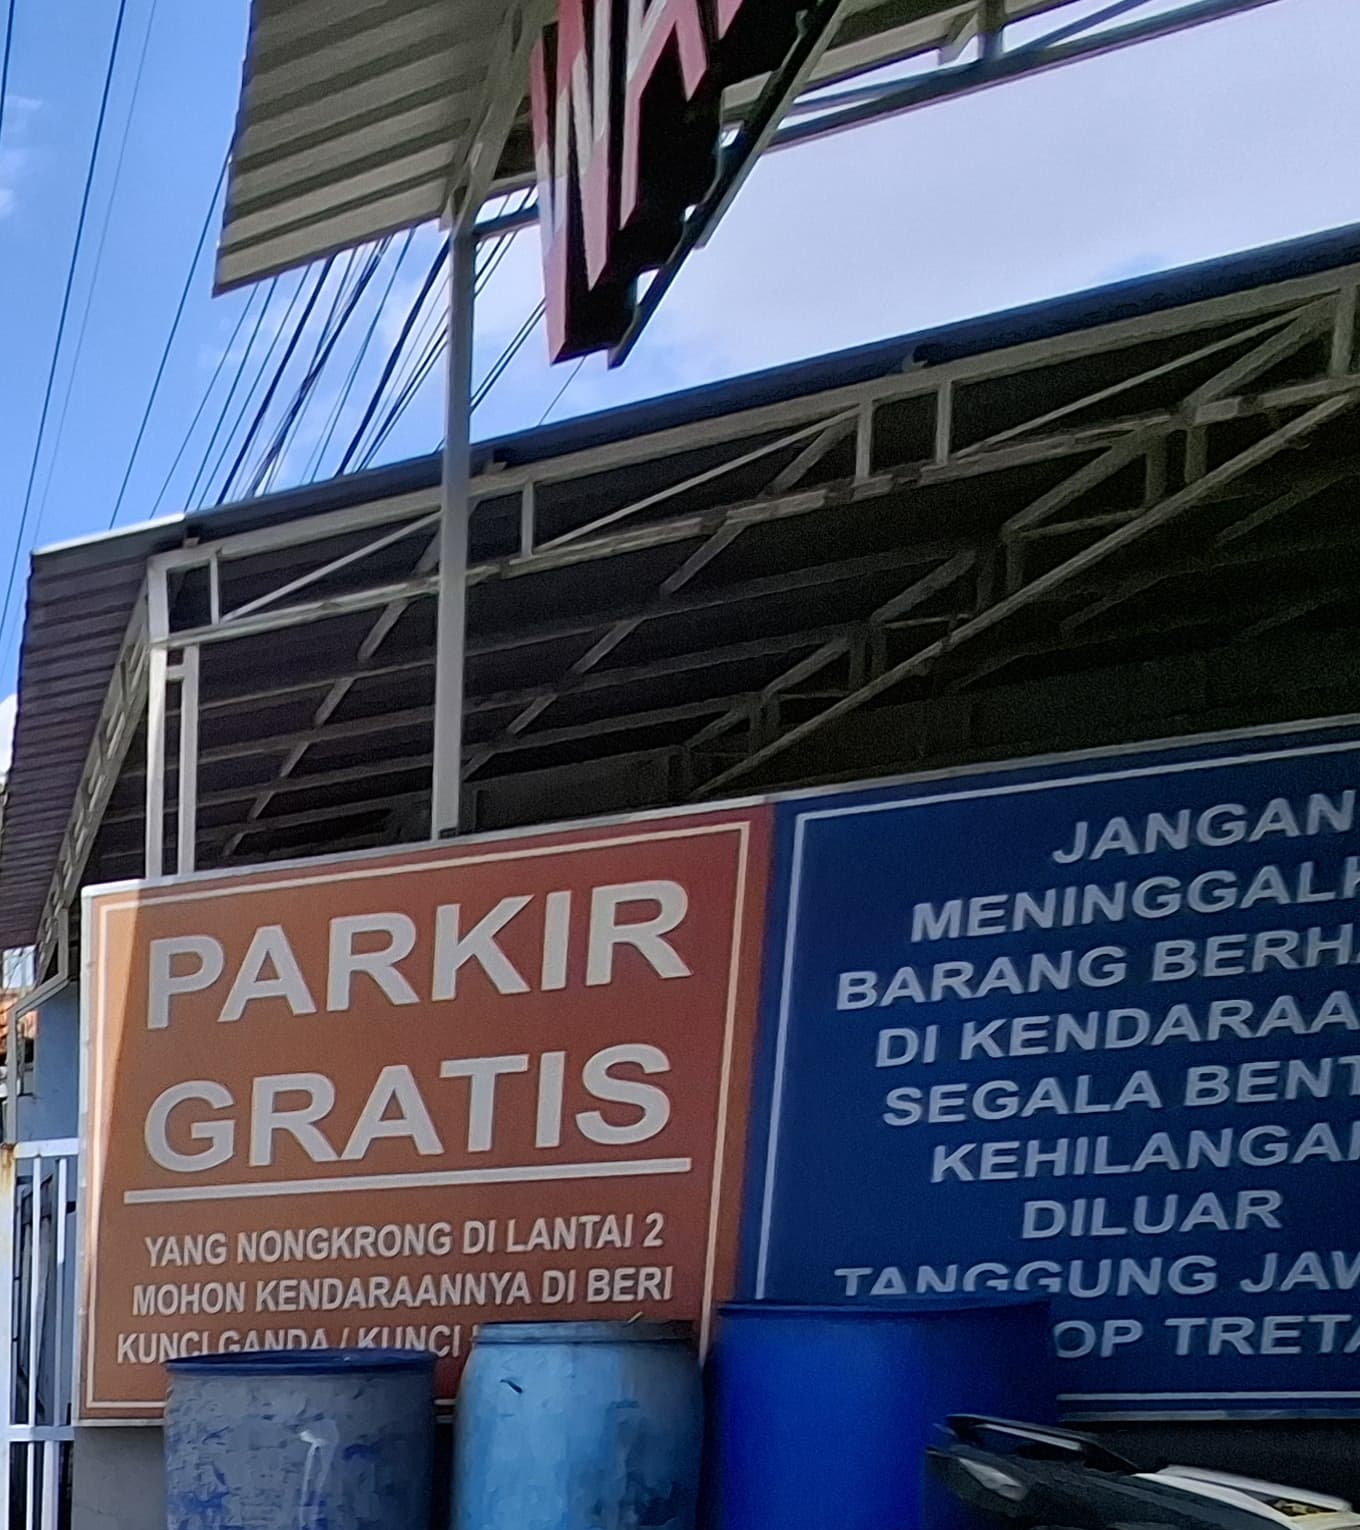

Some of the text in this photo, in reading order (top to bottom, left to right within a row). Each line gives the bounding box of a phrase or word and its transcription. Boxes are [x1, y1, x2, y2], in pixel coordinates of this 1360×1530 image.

[1051, 790, 1357, 864] JANGAN
[146, 880, 692, 1030] PARKIR
[836, 922, 1360, 1010] BARANG BERH
[875, 1024, 938, 1067] DI
[144, 1043, 672, 1172] GRATIS
[882, 1069, 1162, 1127] SEGALA
[930, 1120, 1360, 1183] KEHILANGA
[145, 1212, 665, 1268] YANG NONGKRONG DI LANTAI 2
[1022, 1189, 1283, 1239] DILUAR
[132, 1266, 673, 1317] MOHON KENDARAANNYA DI BERI
[834, 1254, 1218, 1298] TANGGUNG
[116, 1330, 210, 1364] KUNCI
[357, 1325, 461, 1358] KUNCI
